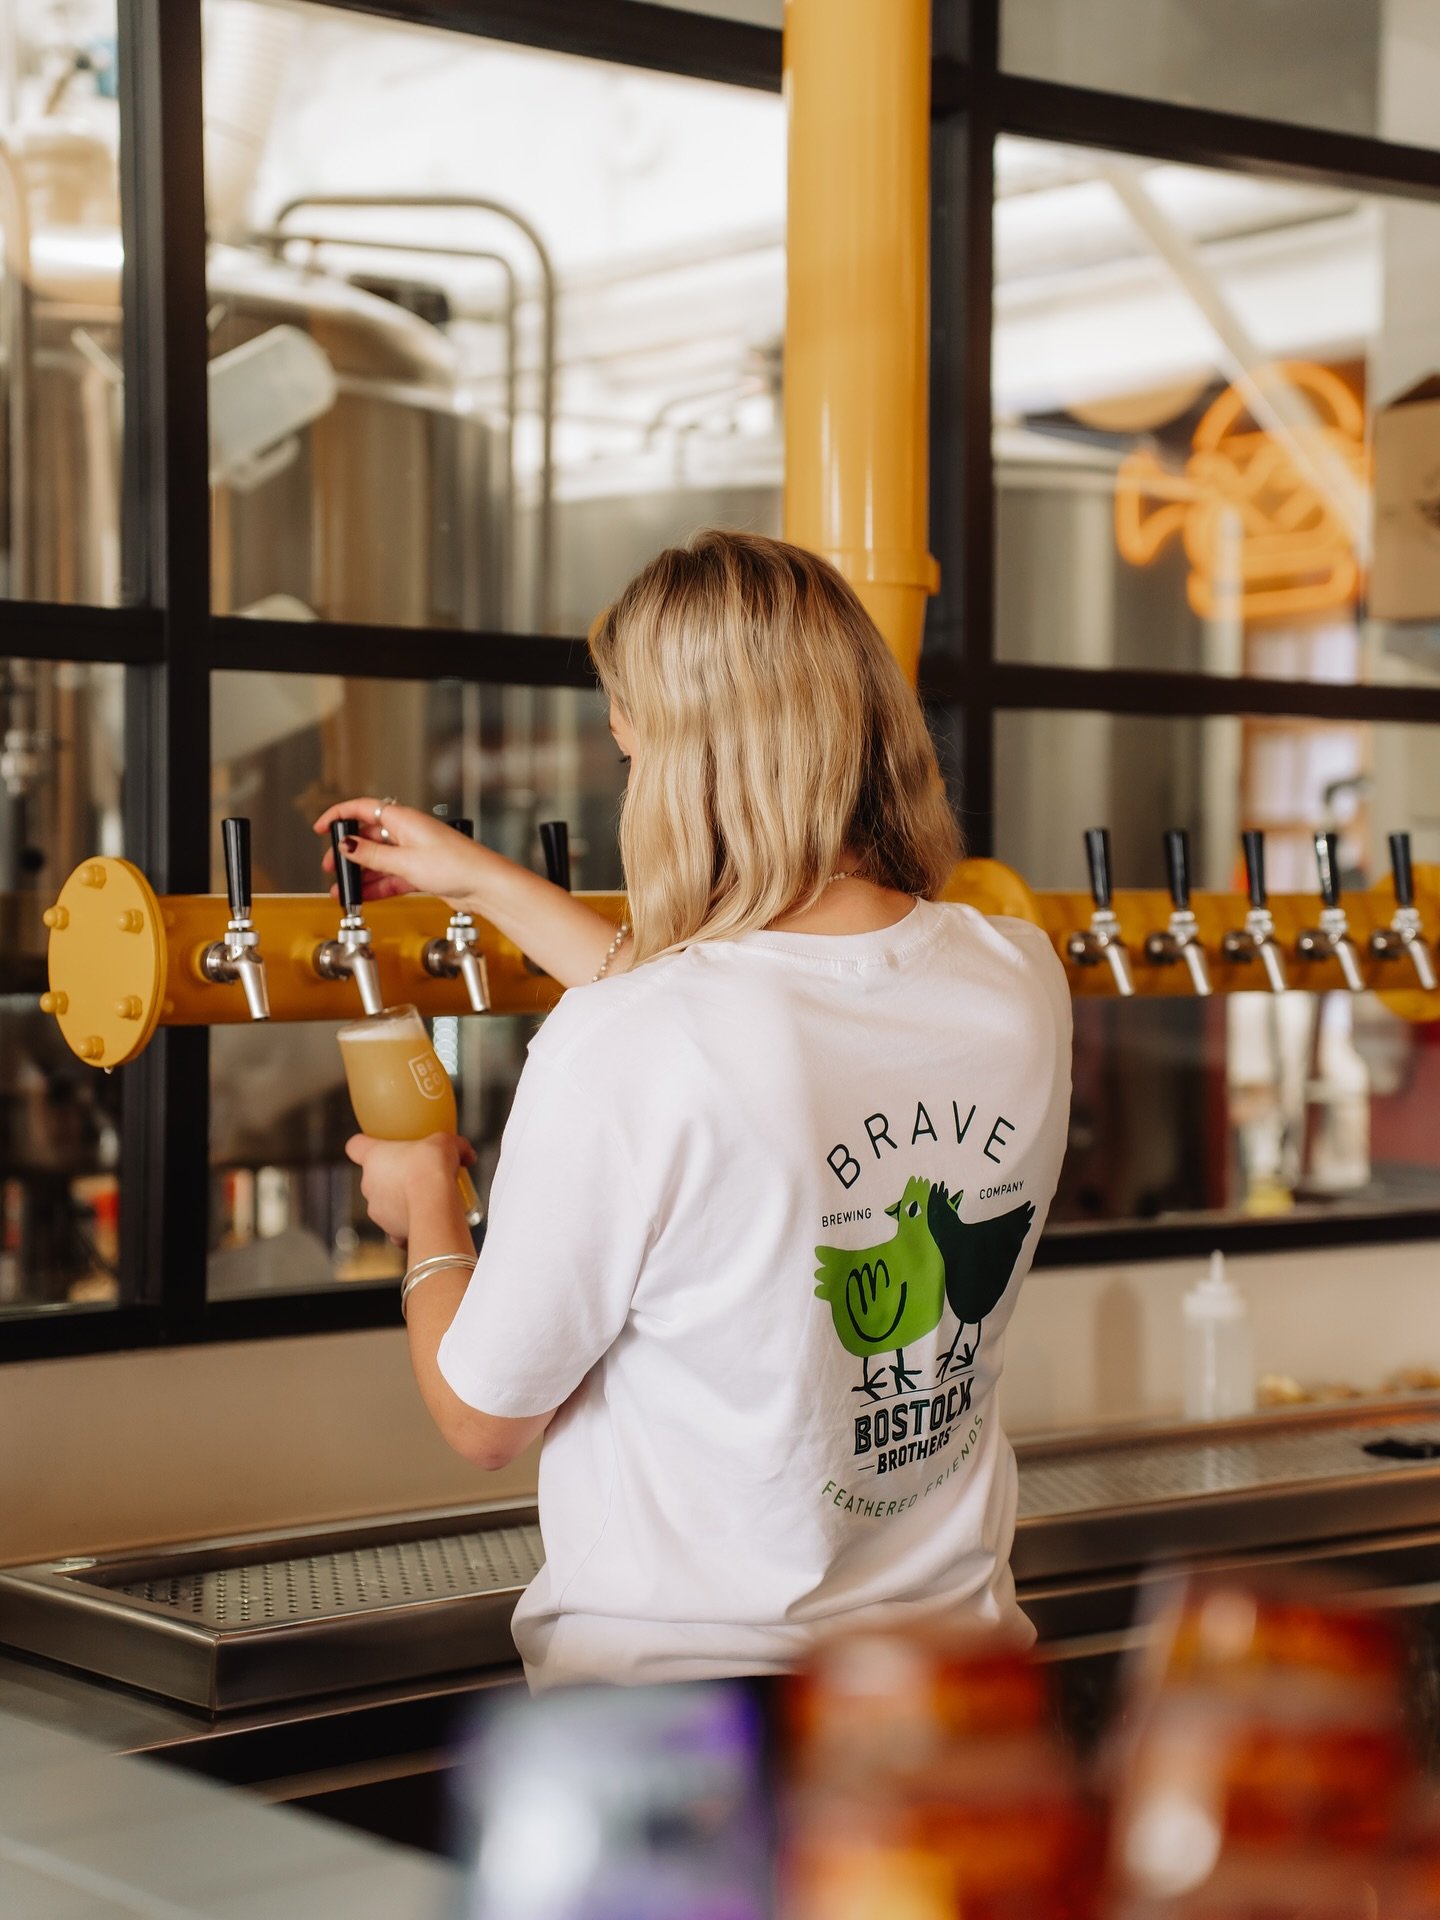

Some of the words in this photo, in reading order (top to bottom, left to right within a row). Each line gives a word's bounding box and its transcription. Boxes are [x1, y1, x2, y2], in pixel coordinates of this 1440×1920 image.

[826, 1100, 1015, 1189] BRAVE
[821, 1207, 872, 1227] BREWING
[979, 1180, 1024, 1200] COMPANY
[853, 1376, 975, 1455] BOSTOCK
[876, 1426, 951, 1474] BROTHERS
[821, 1480, 918, 1517] FEATHERED
[924, 1414, 983, 1497] FRIENDS
